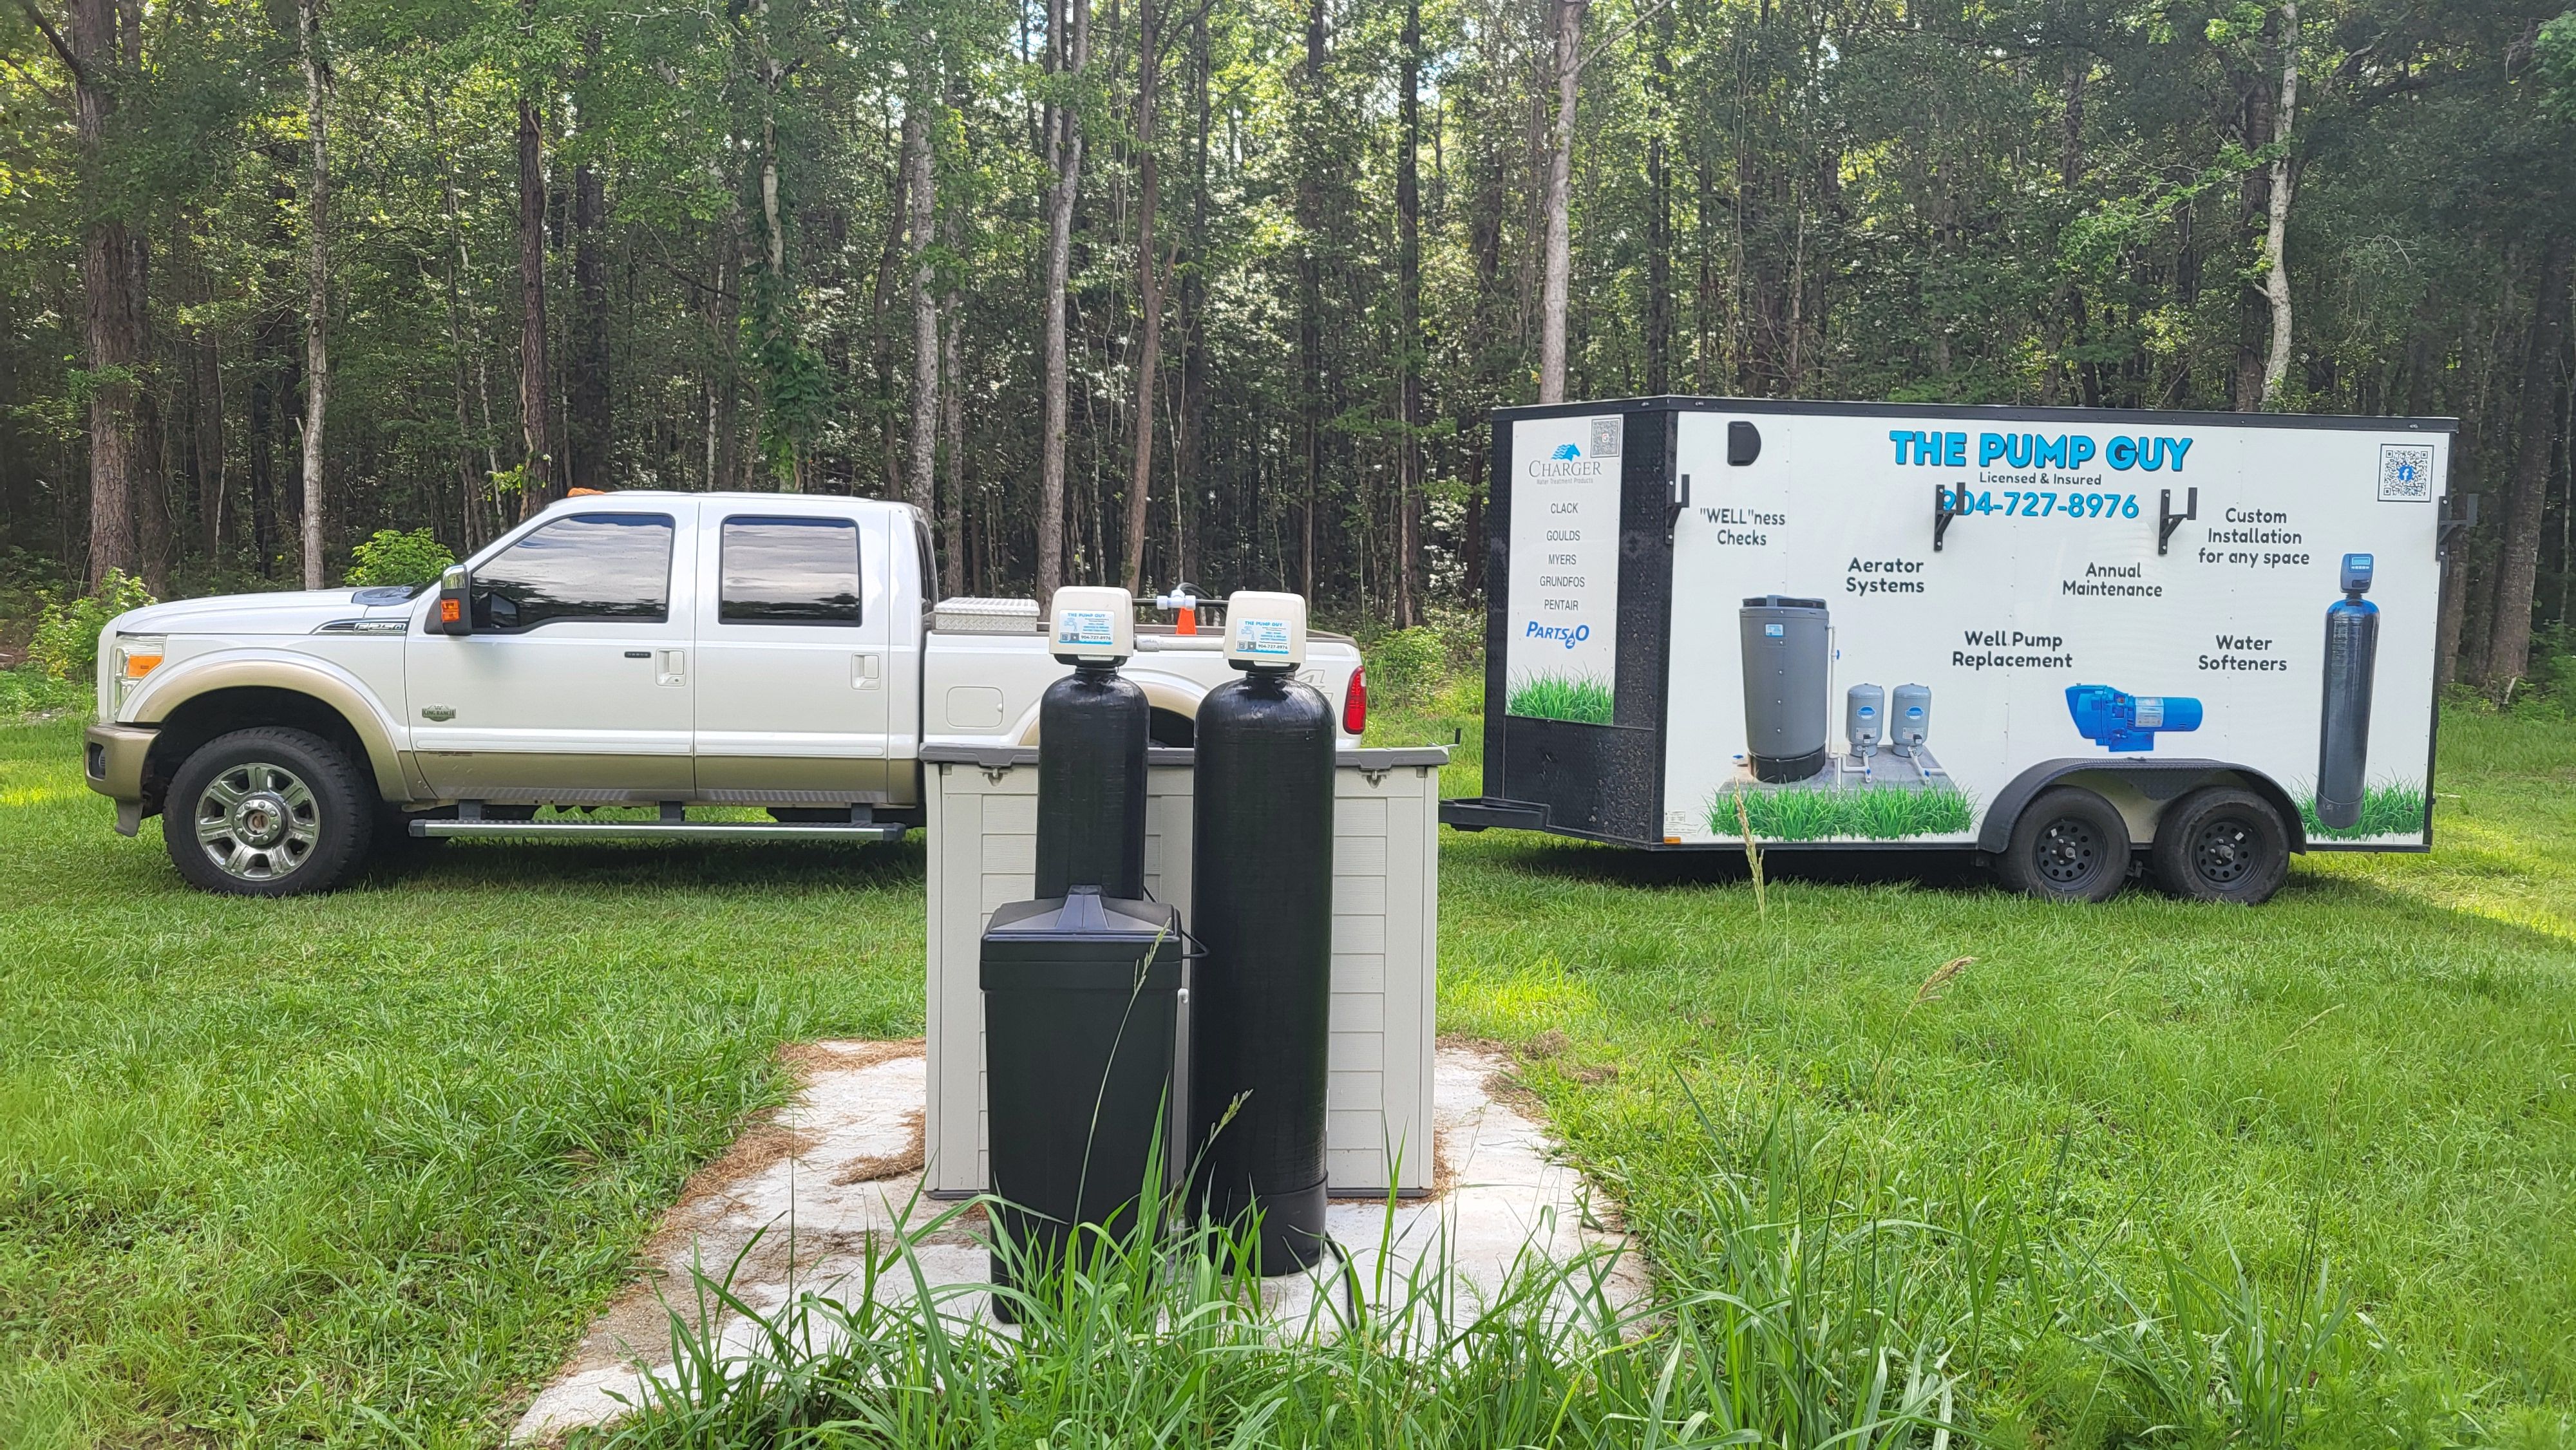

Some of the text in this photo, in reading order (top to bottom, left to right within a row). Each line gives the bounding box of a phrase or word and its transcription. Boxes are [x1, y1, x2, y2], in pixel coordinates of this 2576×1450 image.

[1889, 430, 2193, 472] THE PUMP GUY
[1980, 471, 2101, 485] Licensed & Insured
[1551, 502, 1578, 514] CLACK
[1944, 489, 2139, 518] 904-727-8976
[2225, 507, 2287, 524] Custom
[1546, 530, 1580, 541] GOULDS
[1717, 529, 1766, 546] Checks
[2208, 527, 2302, 545] Installation
[1548, 554, 1577, 565] MYERS
[1847, 556, 1924, 573] Aerator
[2198, 547, 2310, 569] for any space
[2085, 561, 2141, 578] Annual
[1540, 576, 1585, 588] GRUNDFOS
[1846, 576, 1925, 597] Systems
[2062, 579, 2163, 598] Maintenance
[1544, 599, 1578, 611] PENTAIR
[1964, 630, 2063, 652] Well Pump
[2215, 634, 2273, 651] Water
[1952, 650, 2073, 671] Replacement
[2198, 654, 2287, 672] Softeners
